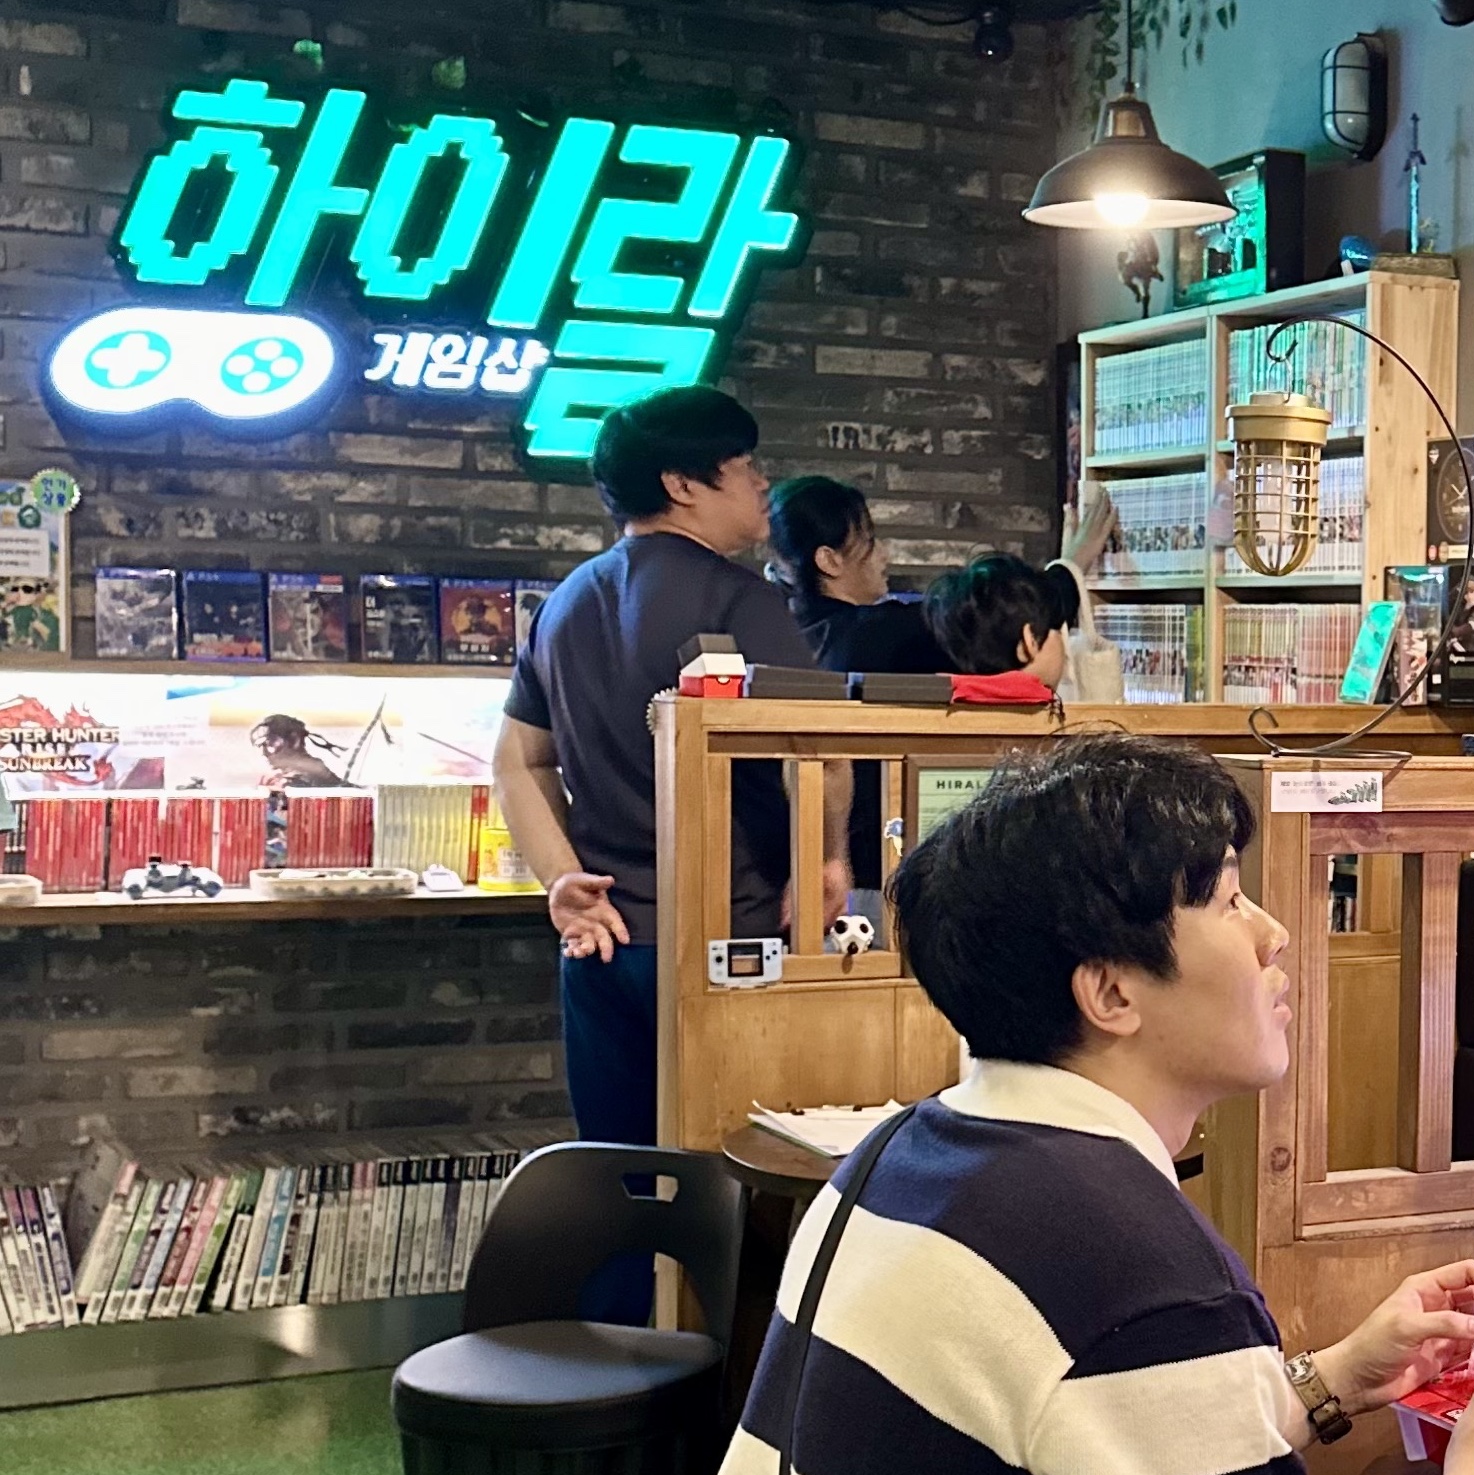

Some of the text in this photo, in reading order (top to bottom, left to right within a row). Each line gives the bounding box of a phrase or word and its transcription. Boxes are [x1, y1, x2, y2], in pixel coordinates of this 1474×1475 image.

[120, 79, 800, 458] 하이랄
[364, 332, 551, 392] 게임샵
[0, 757, 87, 771] SUNBREAK
